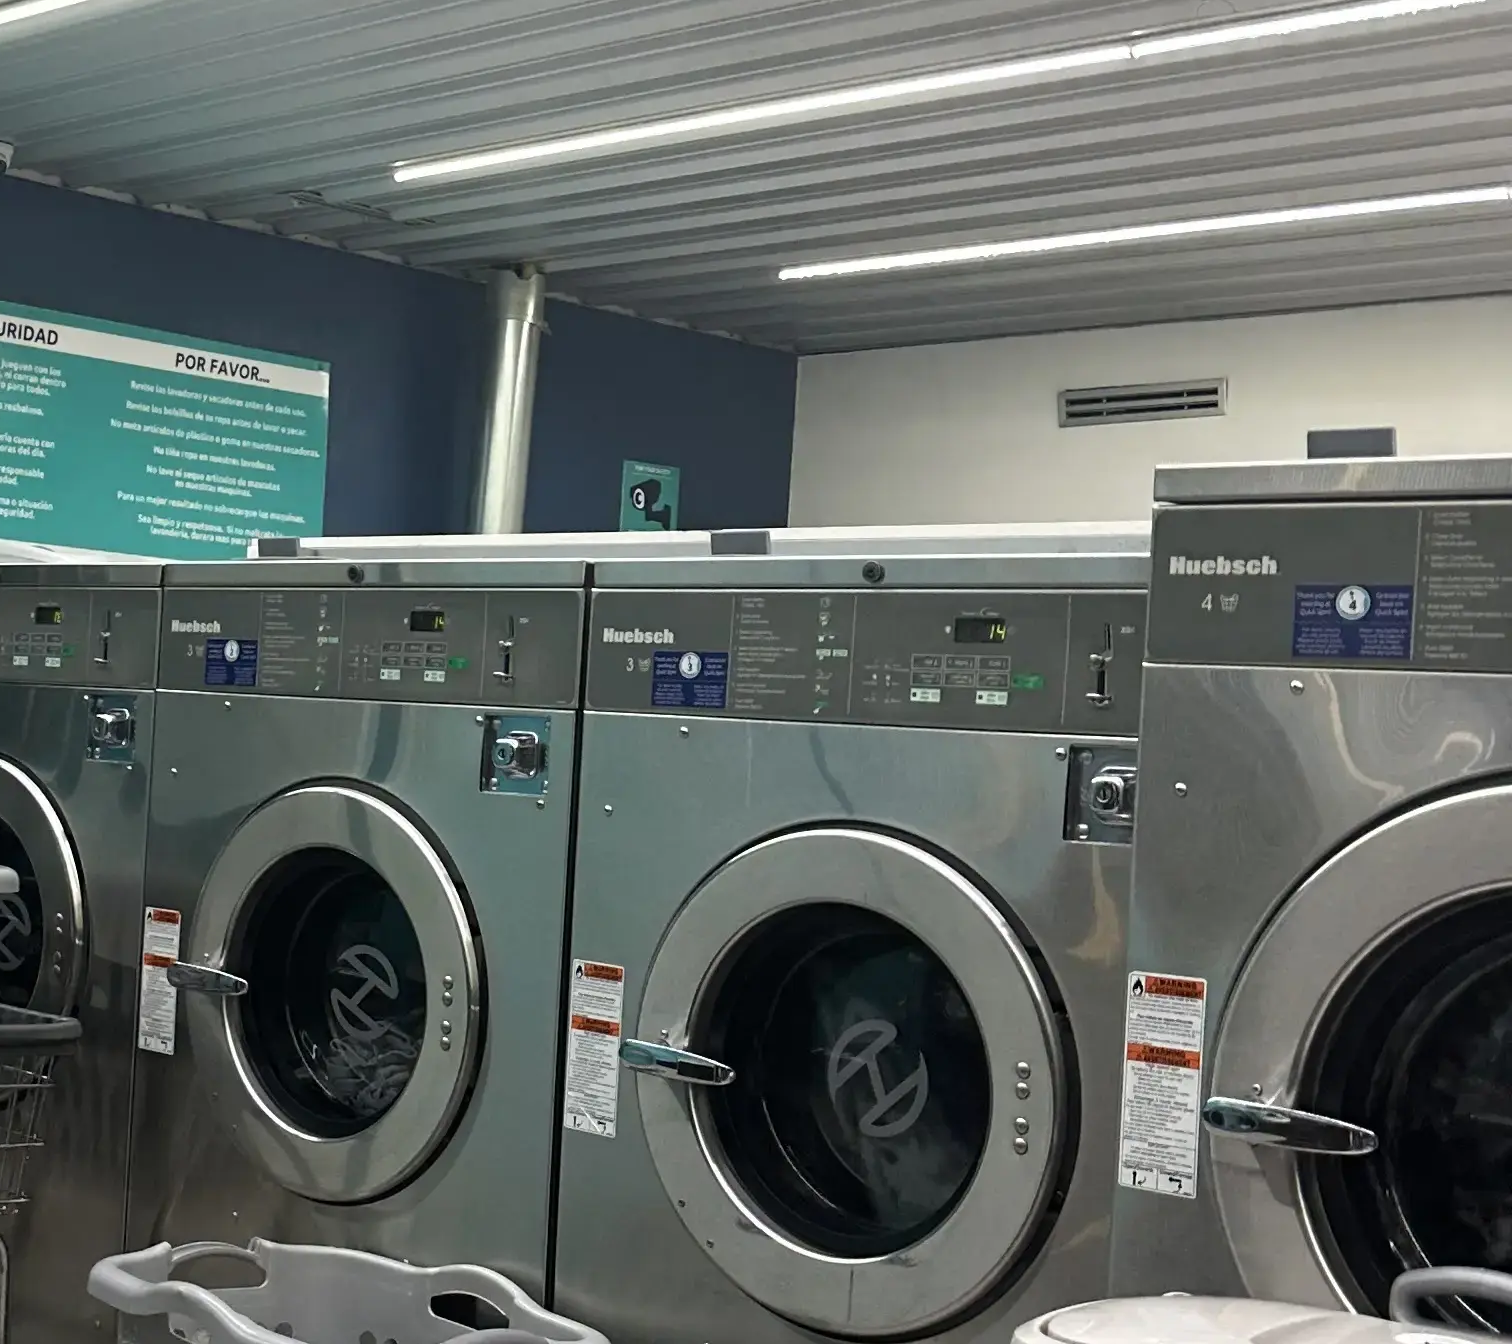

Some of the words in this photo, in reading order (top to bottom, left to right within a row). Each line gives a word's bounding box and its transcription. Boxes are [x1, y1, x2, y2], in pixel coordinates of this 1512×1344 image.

[174, 353, 206, 373] POR
[1169, 555, 1278, 575] Huebsch
[1201, 593, 1212, 611] 4
[171, 619, 221, 633] Huebsch
[989, 623, 1006, 640] 14
[603, 627, 674, 644] Huebsch
[626, 657, 634, 672] 3
